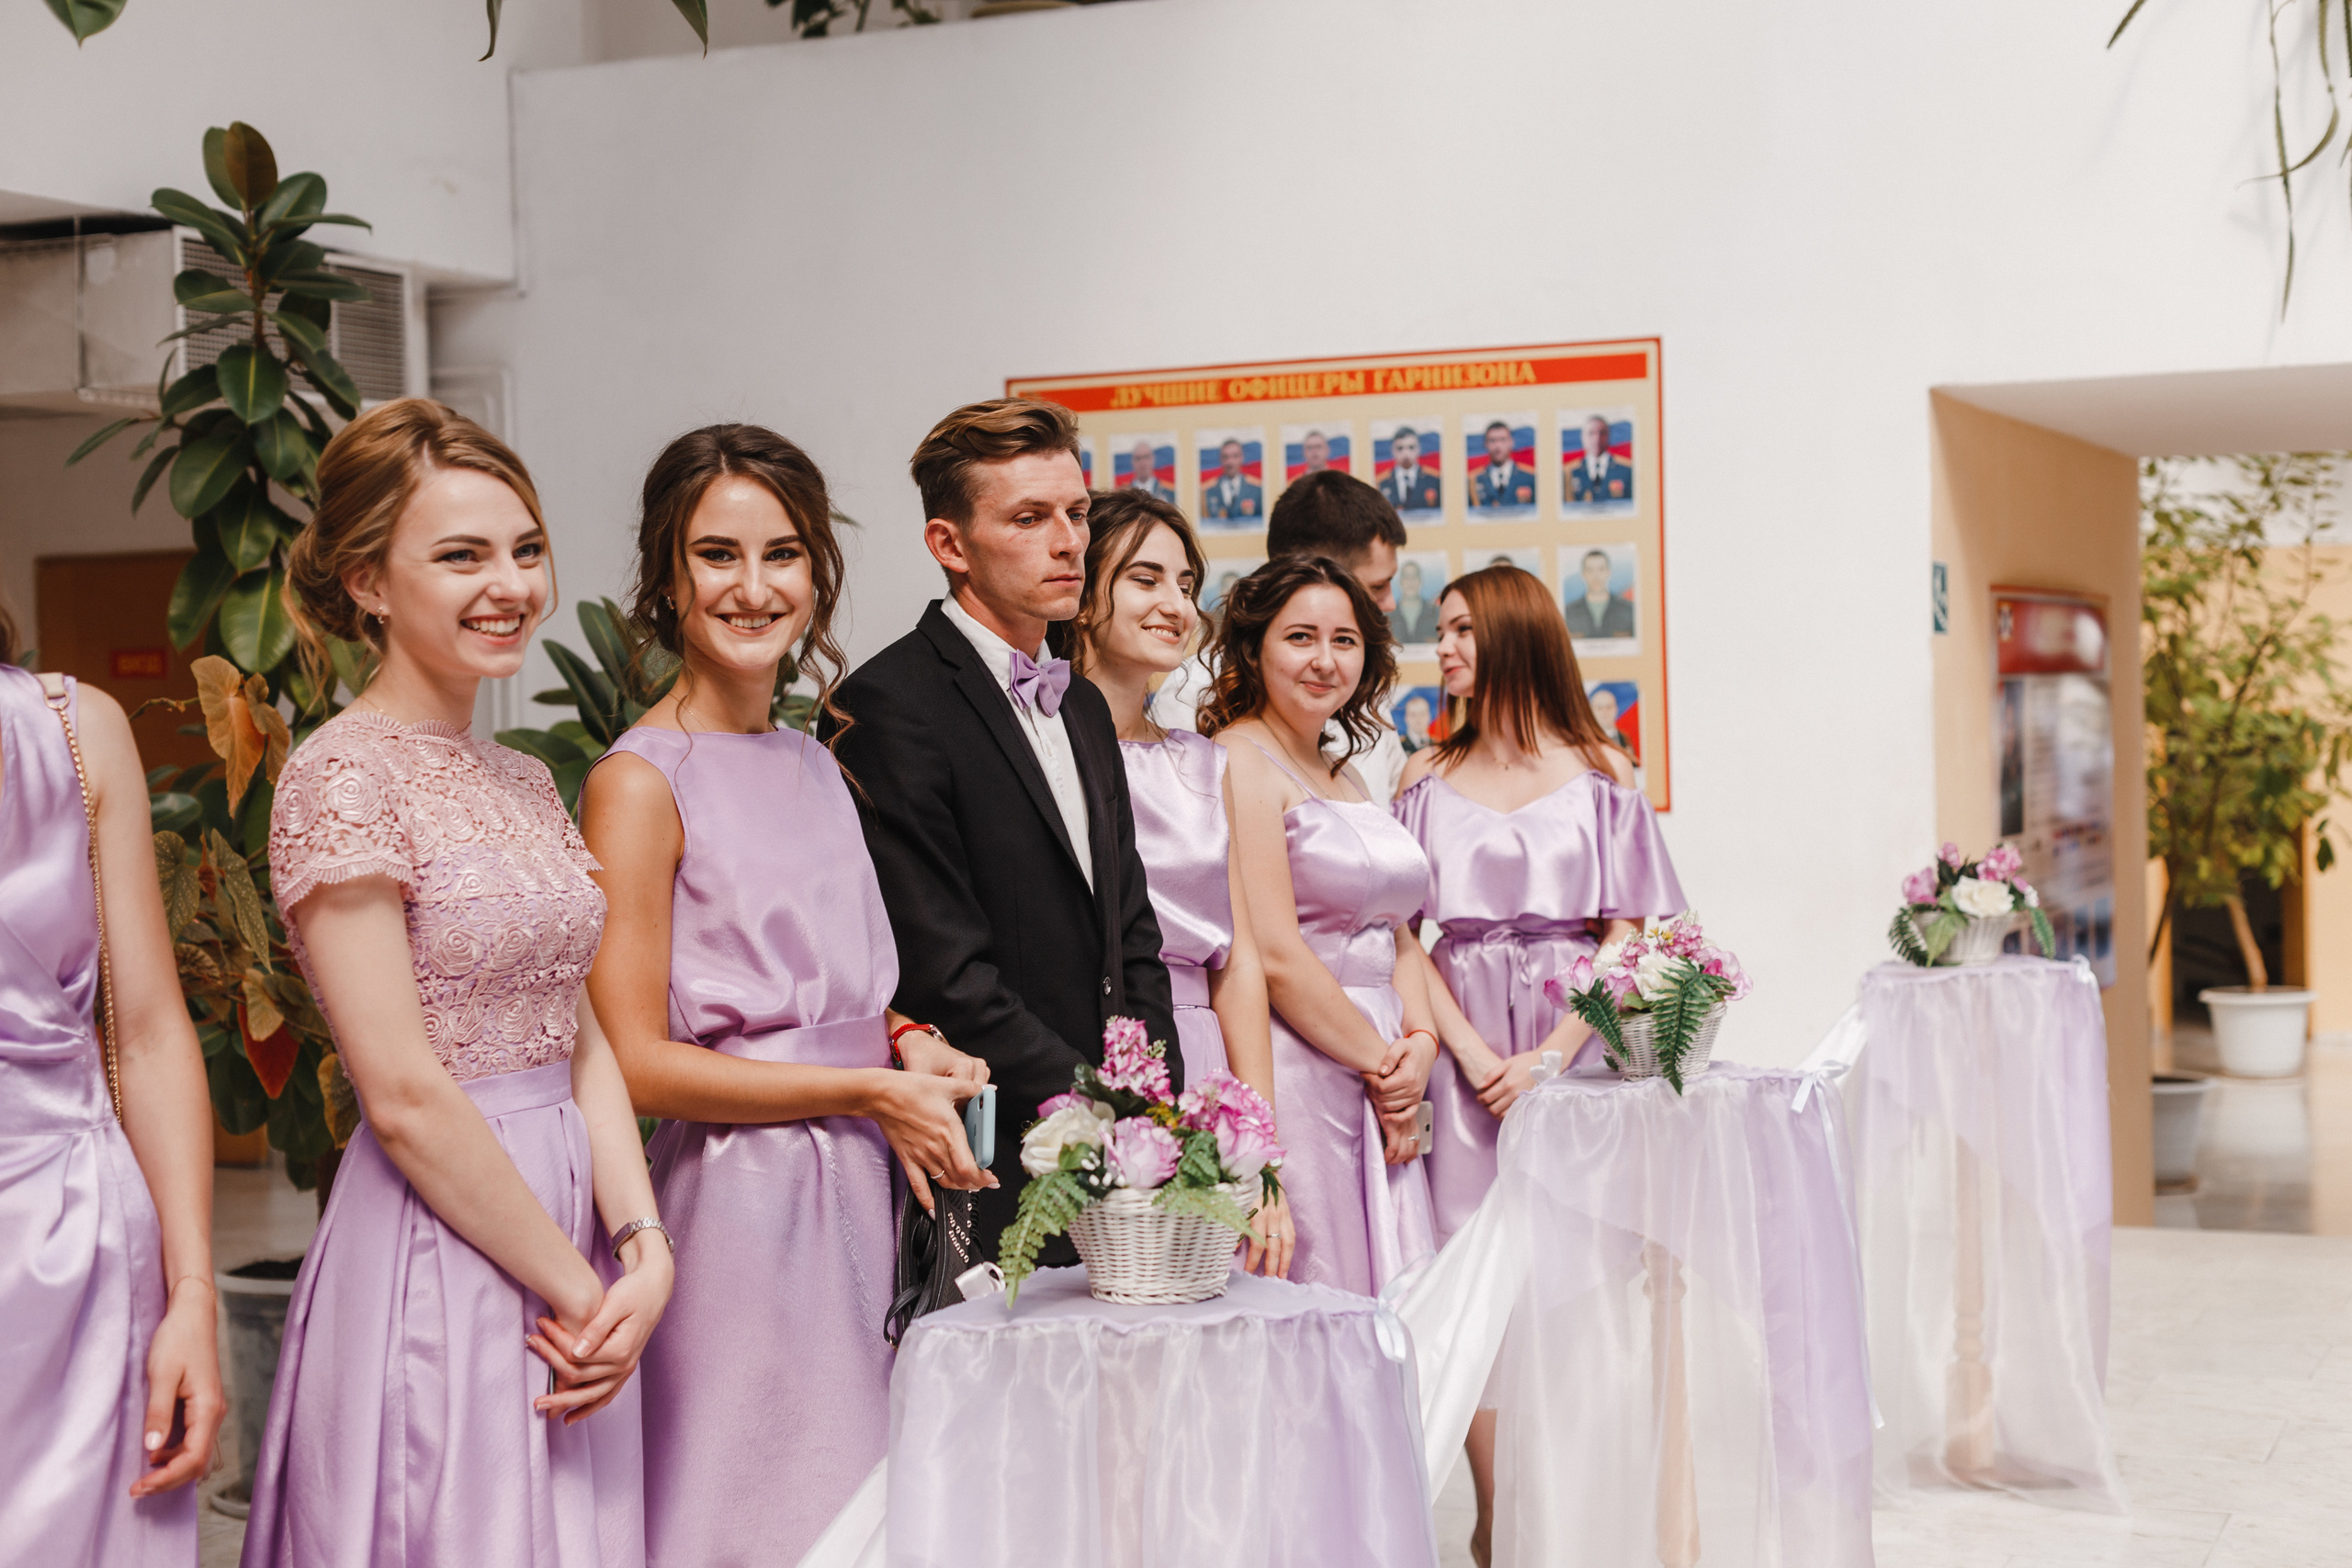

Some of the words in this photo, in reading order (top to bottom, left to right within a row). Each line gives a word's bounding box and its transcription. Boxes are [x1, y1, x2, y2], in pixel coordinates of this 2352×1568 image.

[1110, 380, 1221, 408] ЛУЧШИЕ
[1229, 372, 1364, 399] ОФИЦЕРЫ
[1374, 362, 1536, 391] ГАРНИЗОНА
